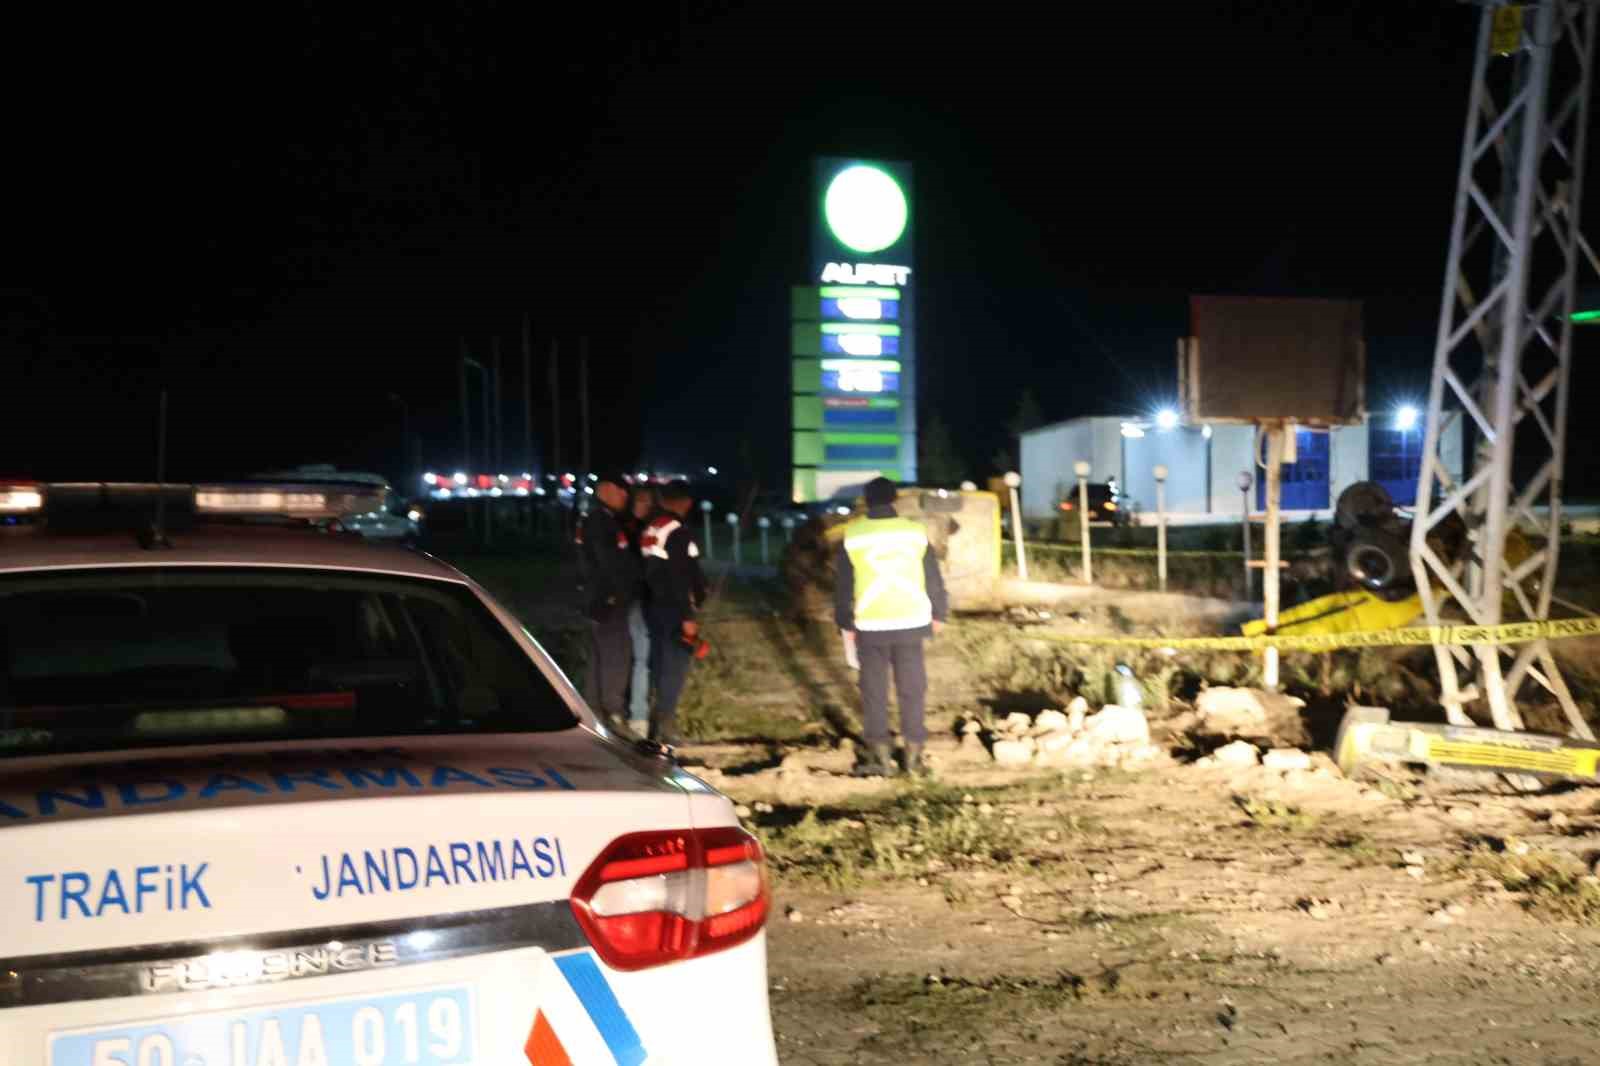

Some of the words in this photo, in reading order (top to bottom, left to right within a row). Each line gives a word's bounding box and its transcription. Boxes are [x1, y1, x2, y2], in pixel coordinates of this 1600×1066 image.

[312, 837, 567, 901] JANDARMASI
[143, 942, 397, 993] FLENCE
[351, 997, 461, 1066] 019
